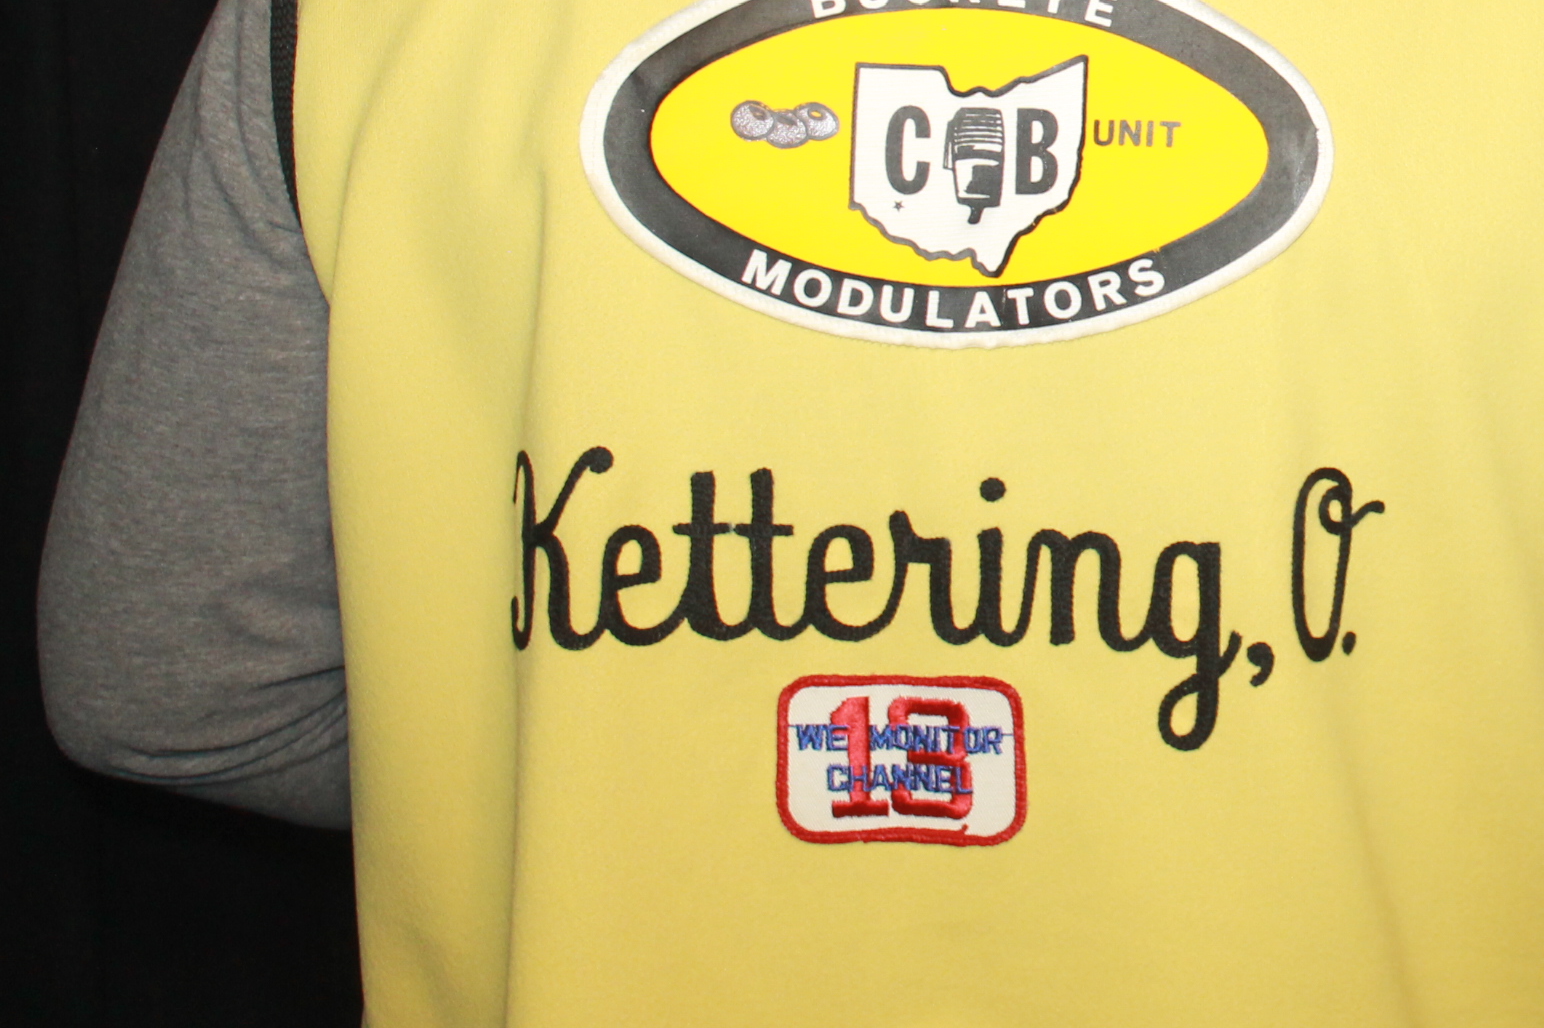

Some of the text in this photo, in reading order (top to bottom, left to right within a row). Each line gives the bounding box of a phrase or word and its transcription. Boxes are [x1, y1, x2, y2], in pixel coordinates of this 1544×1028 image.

[1093, 119, 1181, 148] UNIT
[740, 249, 1166, 329] MODULATORS
[511, 445, 1276, 751] Kettering,
[796, 724, 1003, 755] WE MONITOR
[829, 695, 974, 820] 13
[826, 763, 974, 795] CHANNEL
